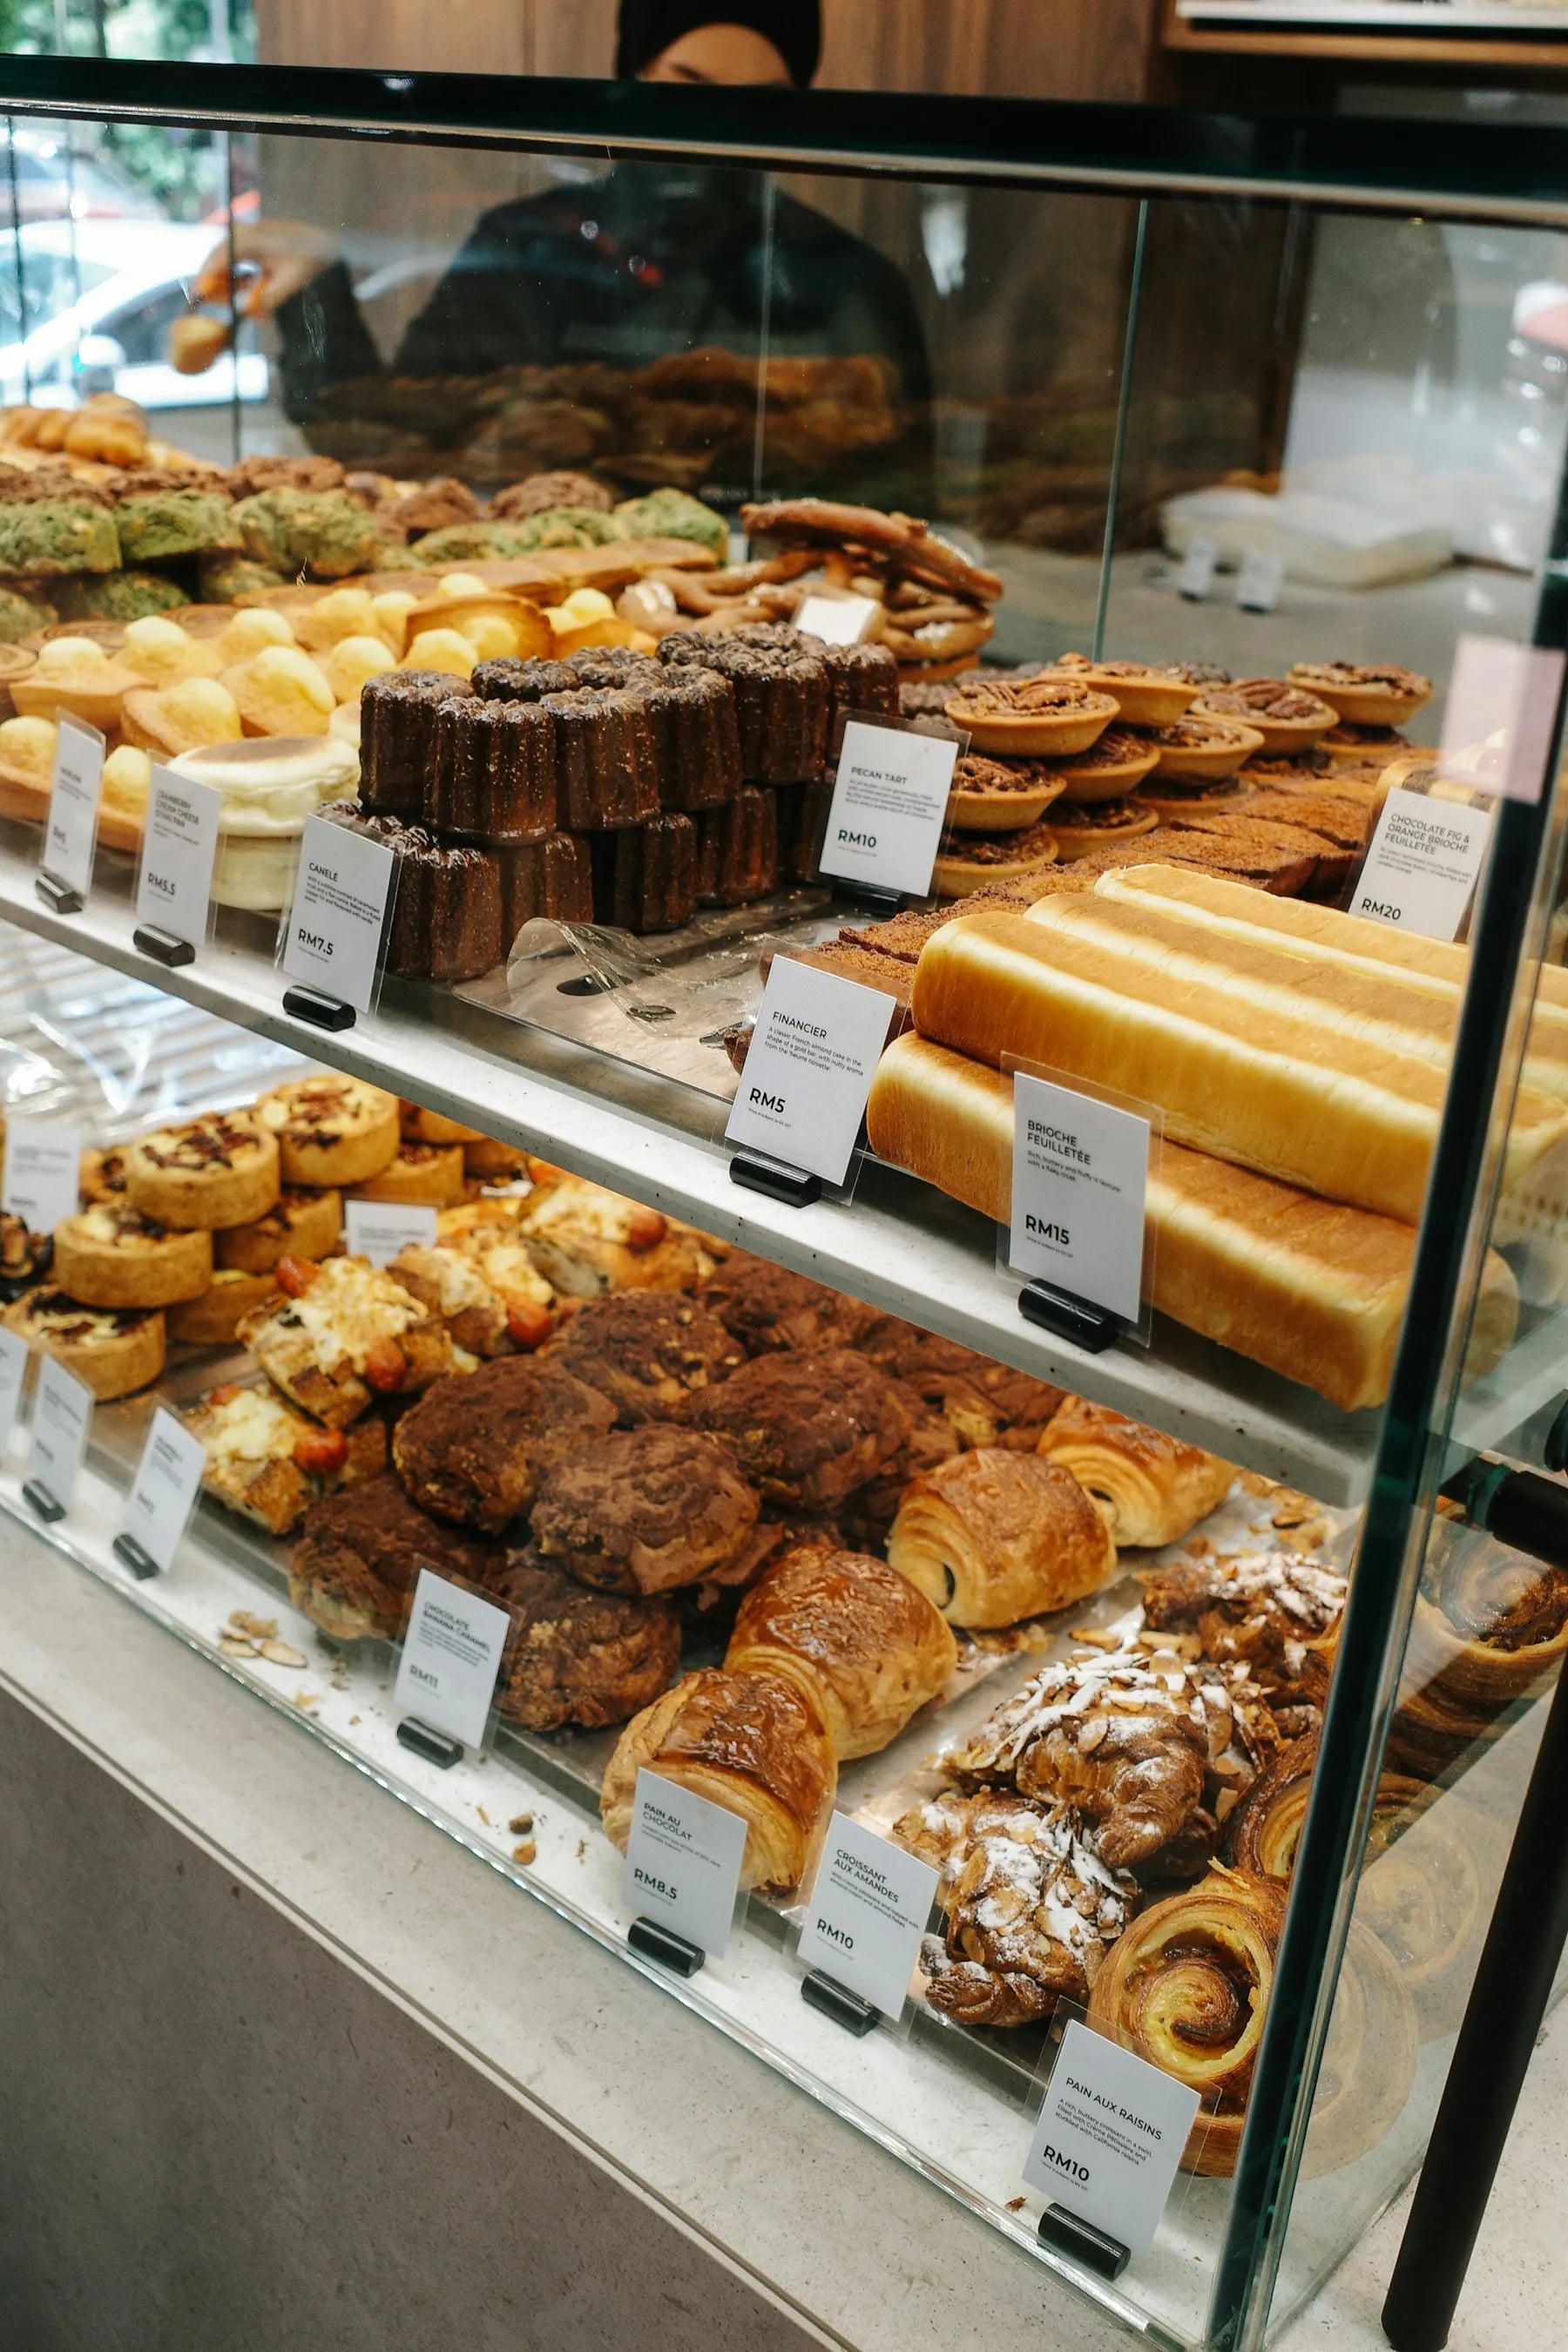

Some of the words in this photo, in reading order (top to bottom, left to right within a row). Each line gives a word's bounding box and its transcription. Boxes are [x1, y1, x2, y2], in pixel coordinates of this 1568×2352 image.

[850, 767, 882, 780] PECAN
[885, 773, 907, 784] TART
[838, 829, 876, 848] RM10
[1388, 823, 1427, 841] ORANGE
[1427, 835, 1469, 854] BRIOCHE
[1390, 814, 1446, 836] CHOCOLATE
[1446, 829, 1463, 841] FIG
[1463, 835, 1470, 843] &
[1384, 832, 1436, 855] FEUILLETÉE
[148, 872, 175, 896] RM5.5
[308, 862, 338, 882] CANELÉ
[1361, 897, 1402, 920] RM20
[298, 928, 334, 956] RM7.5
[772, 1011, 828, 1039] FINANCIER
[764, 1040, 778, 1051] from
[778, 1046, 788, 1055] the
[767, 1034, 783, 1044] shape
[794, 1044, 808, 1054] gold
[807, 1049, 817, 1059] bar,
[830, 1059, 846, 1070] nutty
[846, 1065, 863, 1077] aroma
[774, 1029, 791, 1040] classic
[792, 1034, 811, 1047] French
[811, 1043, 832, 1056] almond
[832, 1051, 846, 1061] cake
[749, 1087, 786, 1113] RM5
[1028, 1119, 1077, 1147] BRIOCHE
[1027, 1132, 1091, 1166] FEUILLETÉE
[1027, 1159, 1040, 1168] with
[1065, 1166, 1077, 1174] and
[1025, 1214, 1070, 1245] RM15
[426, 1602, 469, 1631] CHOCOLATE
[642, 1811, 693, 1841] CHOCOLAT
[644, 1802, 666, 1819] PAIN
[667, 1815, 681, 1827] AU
[836, 1848, 887, 1883] CROISSANT
[634, 1868, 677, 1900] RM8.5
[834, 1858, 853, 1875] AUX
[854, 1870, 899, 1903] AMANDES
[817, 1918, 854, 1950] RM10
[1064, 2101, 1077, 2112] rich,
[1078, 2108, 1099, 2126] buttery
[1099, 2122, 1126, 2140] croissant
[1065, 2077, 1092, 2099] PAIN
[1093, 2094, 1118, 2113] AUX
[1119, 2108, 1162, 2140] RAISINS
[1055, 2112, 1079, 2129] studded
[1079, 2127, 1092, 2137] with
[1093, 2133, 1120, 2153] California
[1058, 2104, 1072, 2117] filled
[1072, 2114, 1085, 2125] with
[1134, 2152, 1146, 2161] and
[1043, 2145, 1090, 2181] RM10
